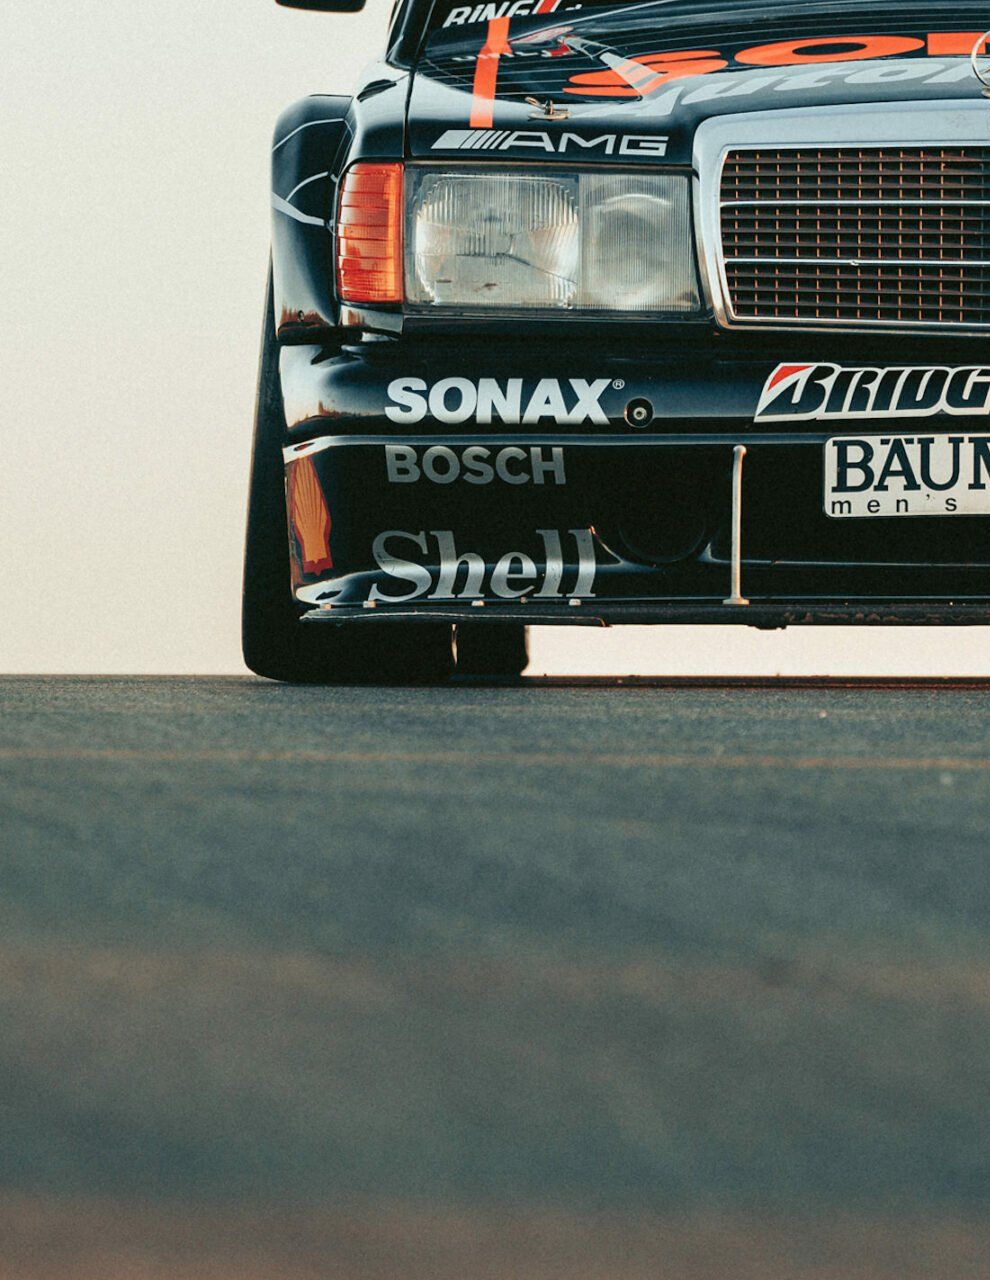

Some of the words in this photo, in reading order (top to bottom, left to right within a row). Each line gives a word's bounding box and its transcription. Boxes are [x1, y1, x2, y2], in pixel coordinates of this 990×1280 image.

[496, 130, 670, 157] AMG
[385, 445, 566, 484] BOSCH
[831, 493, 957, 514] men's
[368, 529, 598, 602] Shell
